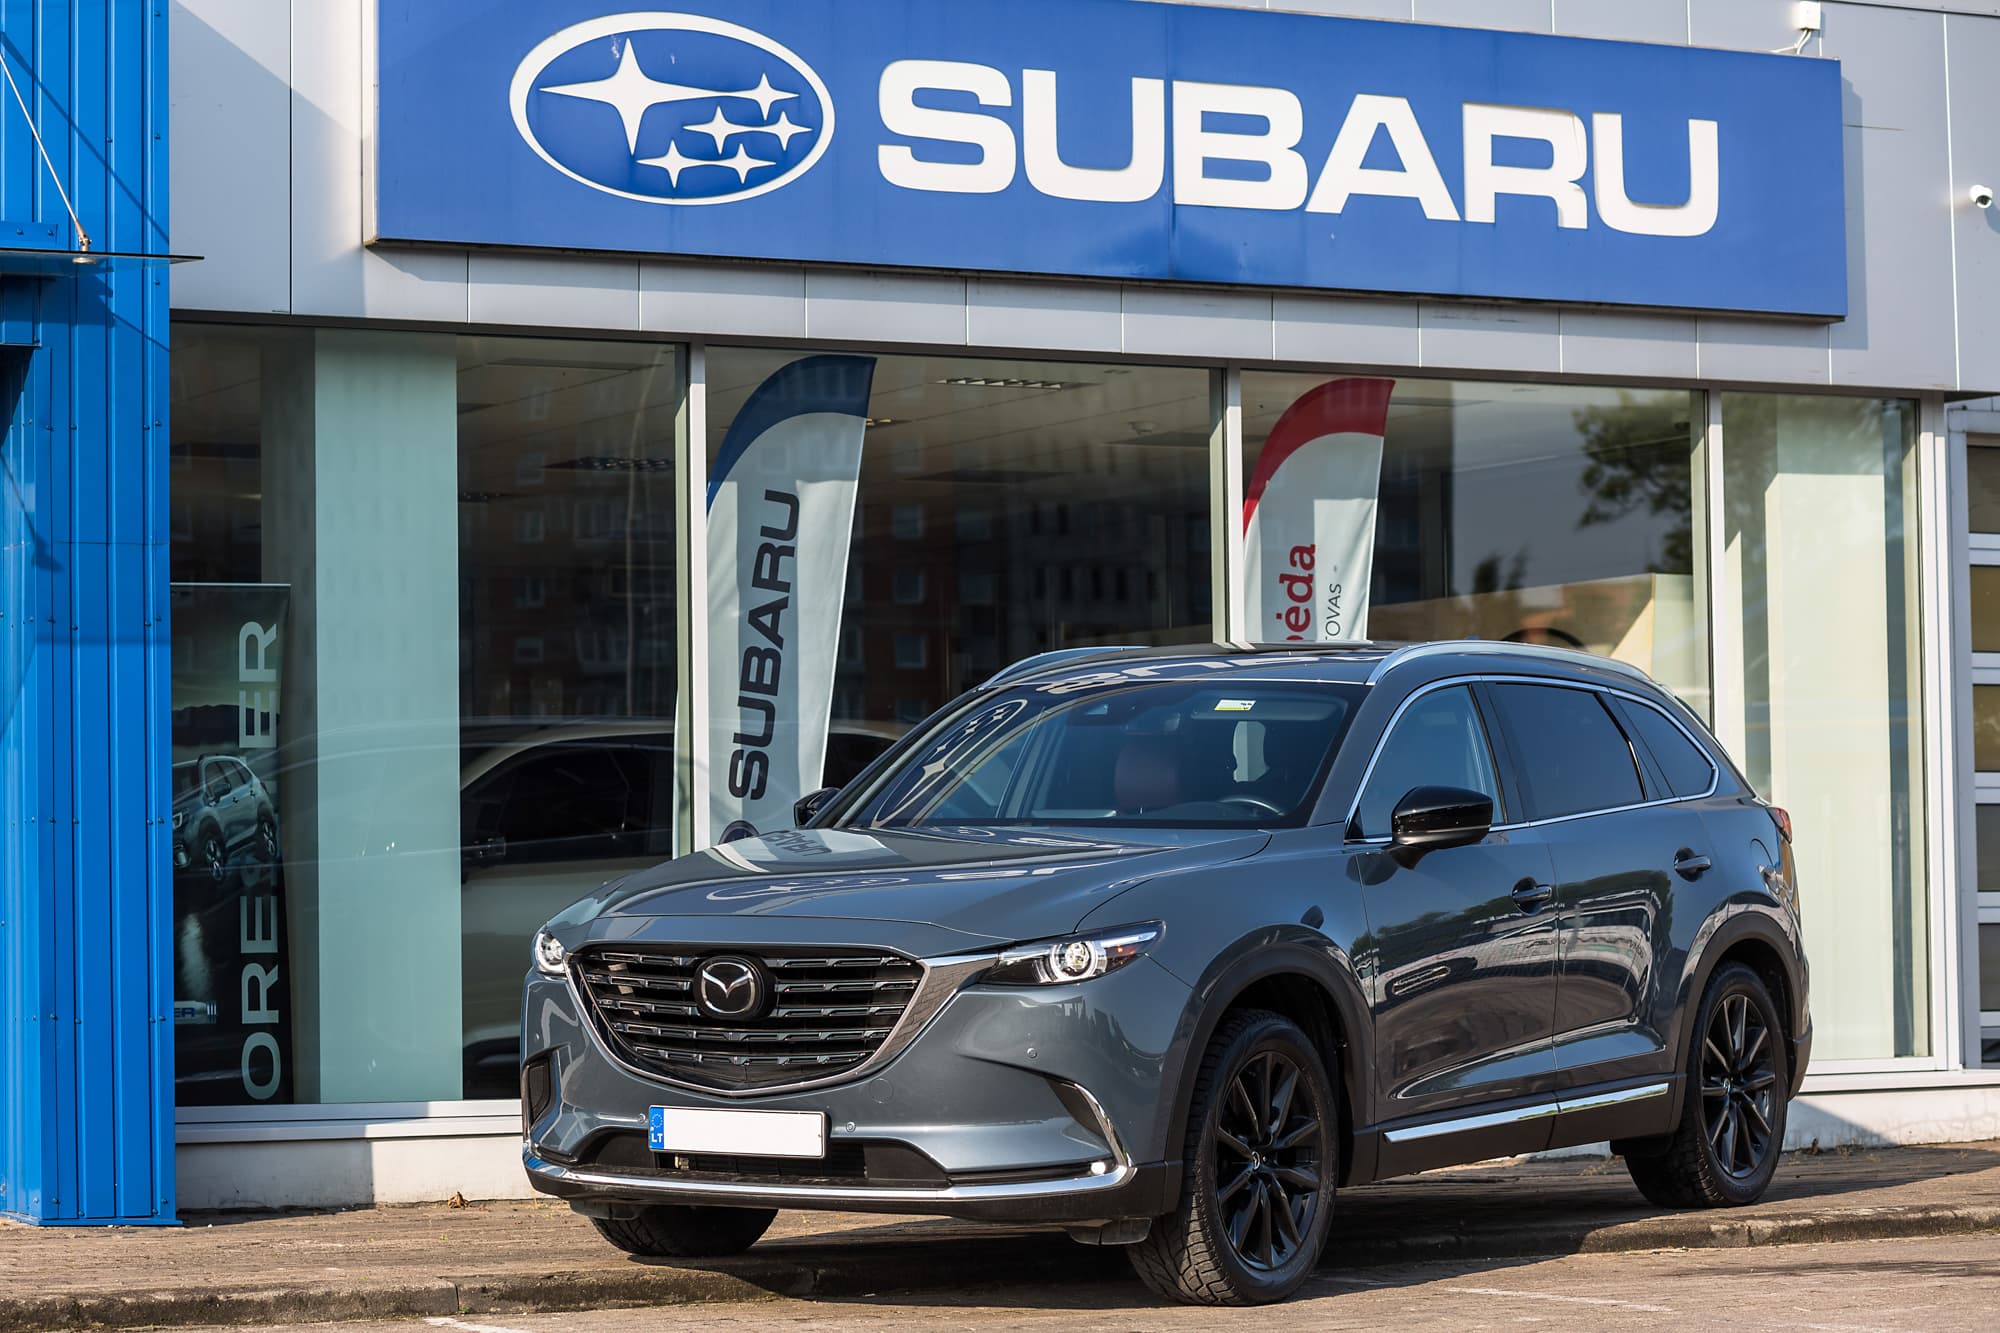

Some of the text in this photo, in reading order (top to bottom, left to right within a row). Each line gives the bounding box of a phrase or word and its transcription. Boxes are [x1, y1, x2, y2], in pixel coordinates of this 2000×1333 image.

[878, 59, 1719, 237] SUBARU
[1275, 544, 1316, 640] ėda
[1325, 583, 1342, 640] OVAS
[728, 489, 800, 800] SUBARU
[651, 1132, 664, 1143] LT
